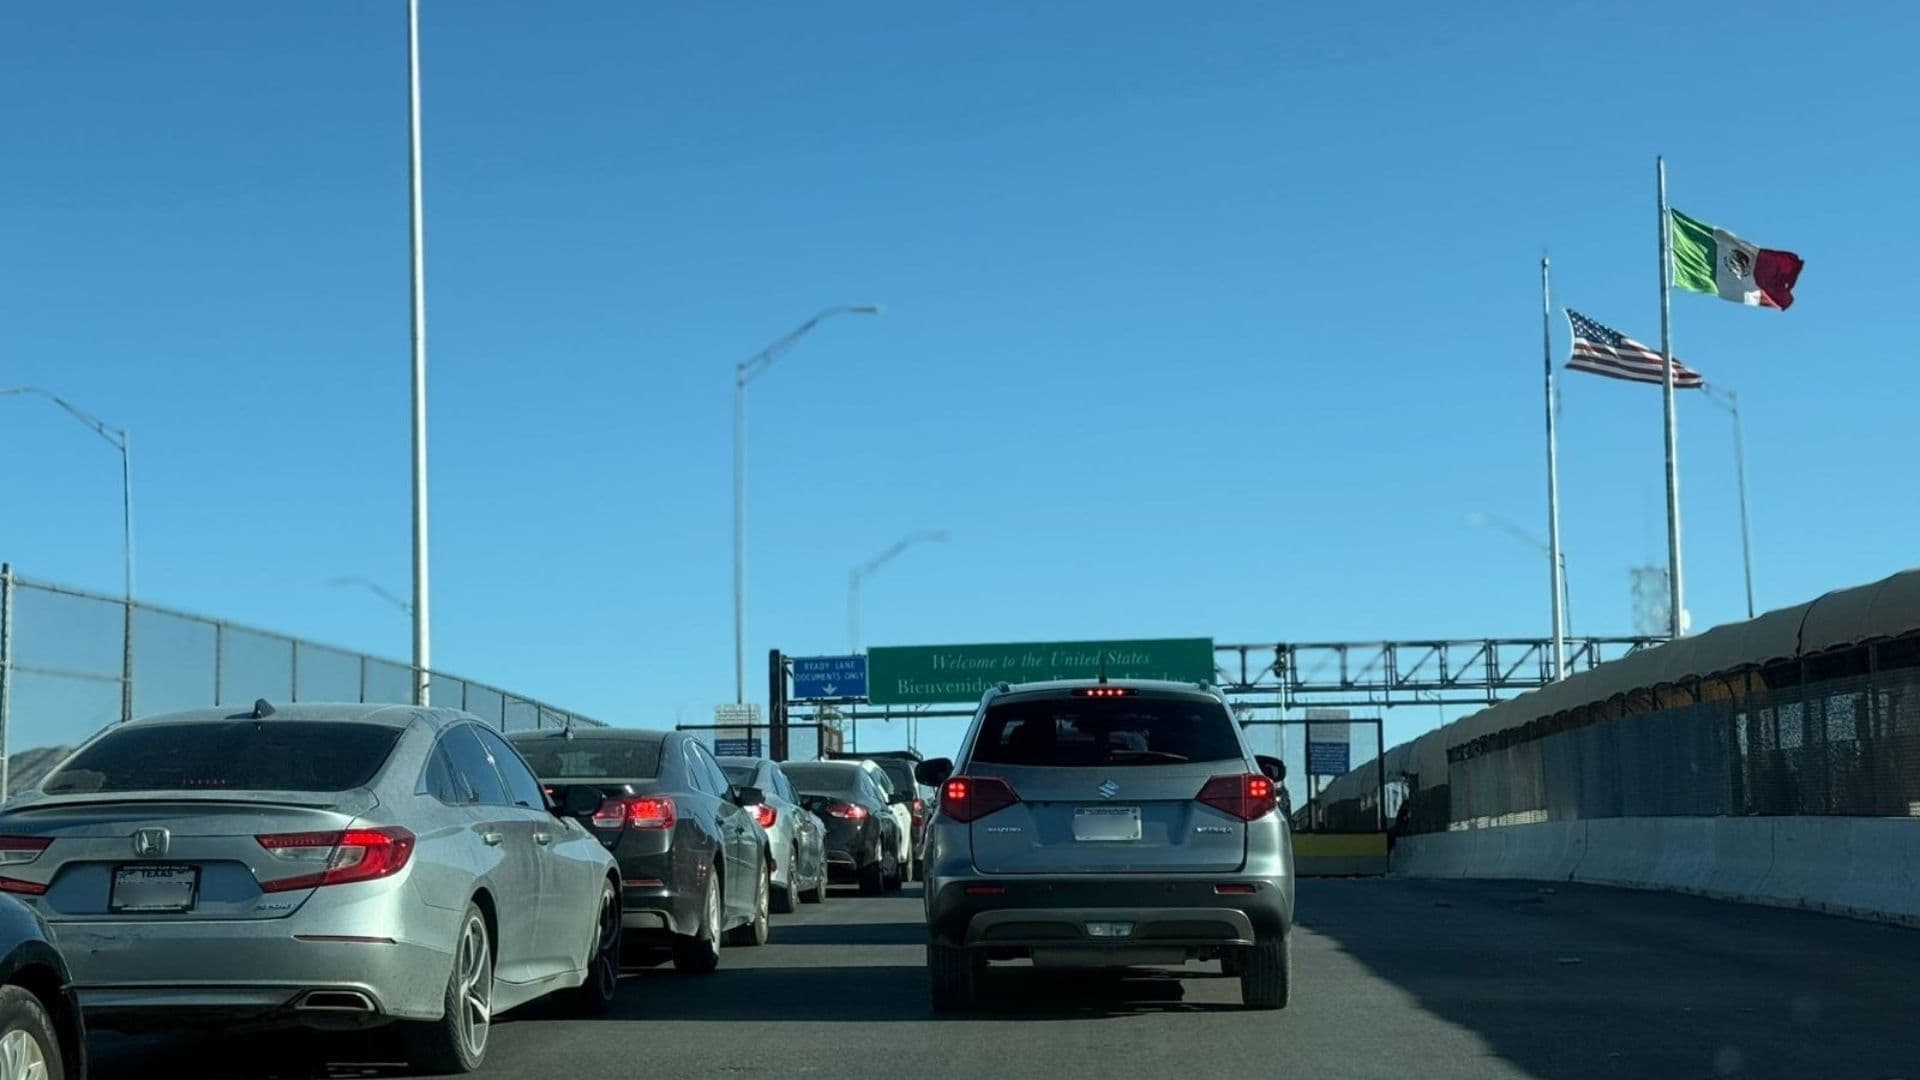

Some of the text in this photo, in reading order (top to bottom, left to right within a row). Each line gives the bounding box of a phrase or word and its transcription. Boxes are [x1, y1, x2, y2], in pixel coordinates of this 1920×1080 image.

[932, 649, 1150, 671] Welcome to the United States
[804, 661, 856, 671] READY LANE
[795, 671, 865, 681] DOCUMENTS ONLY
[898, 676, 997, 694] Bienvenido
[142, 869, 174, 879] TEXAS
